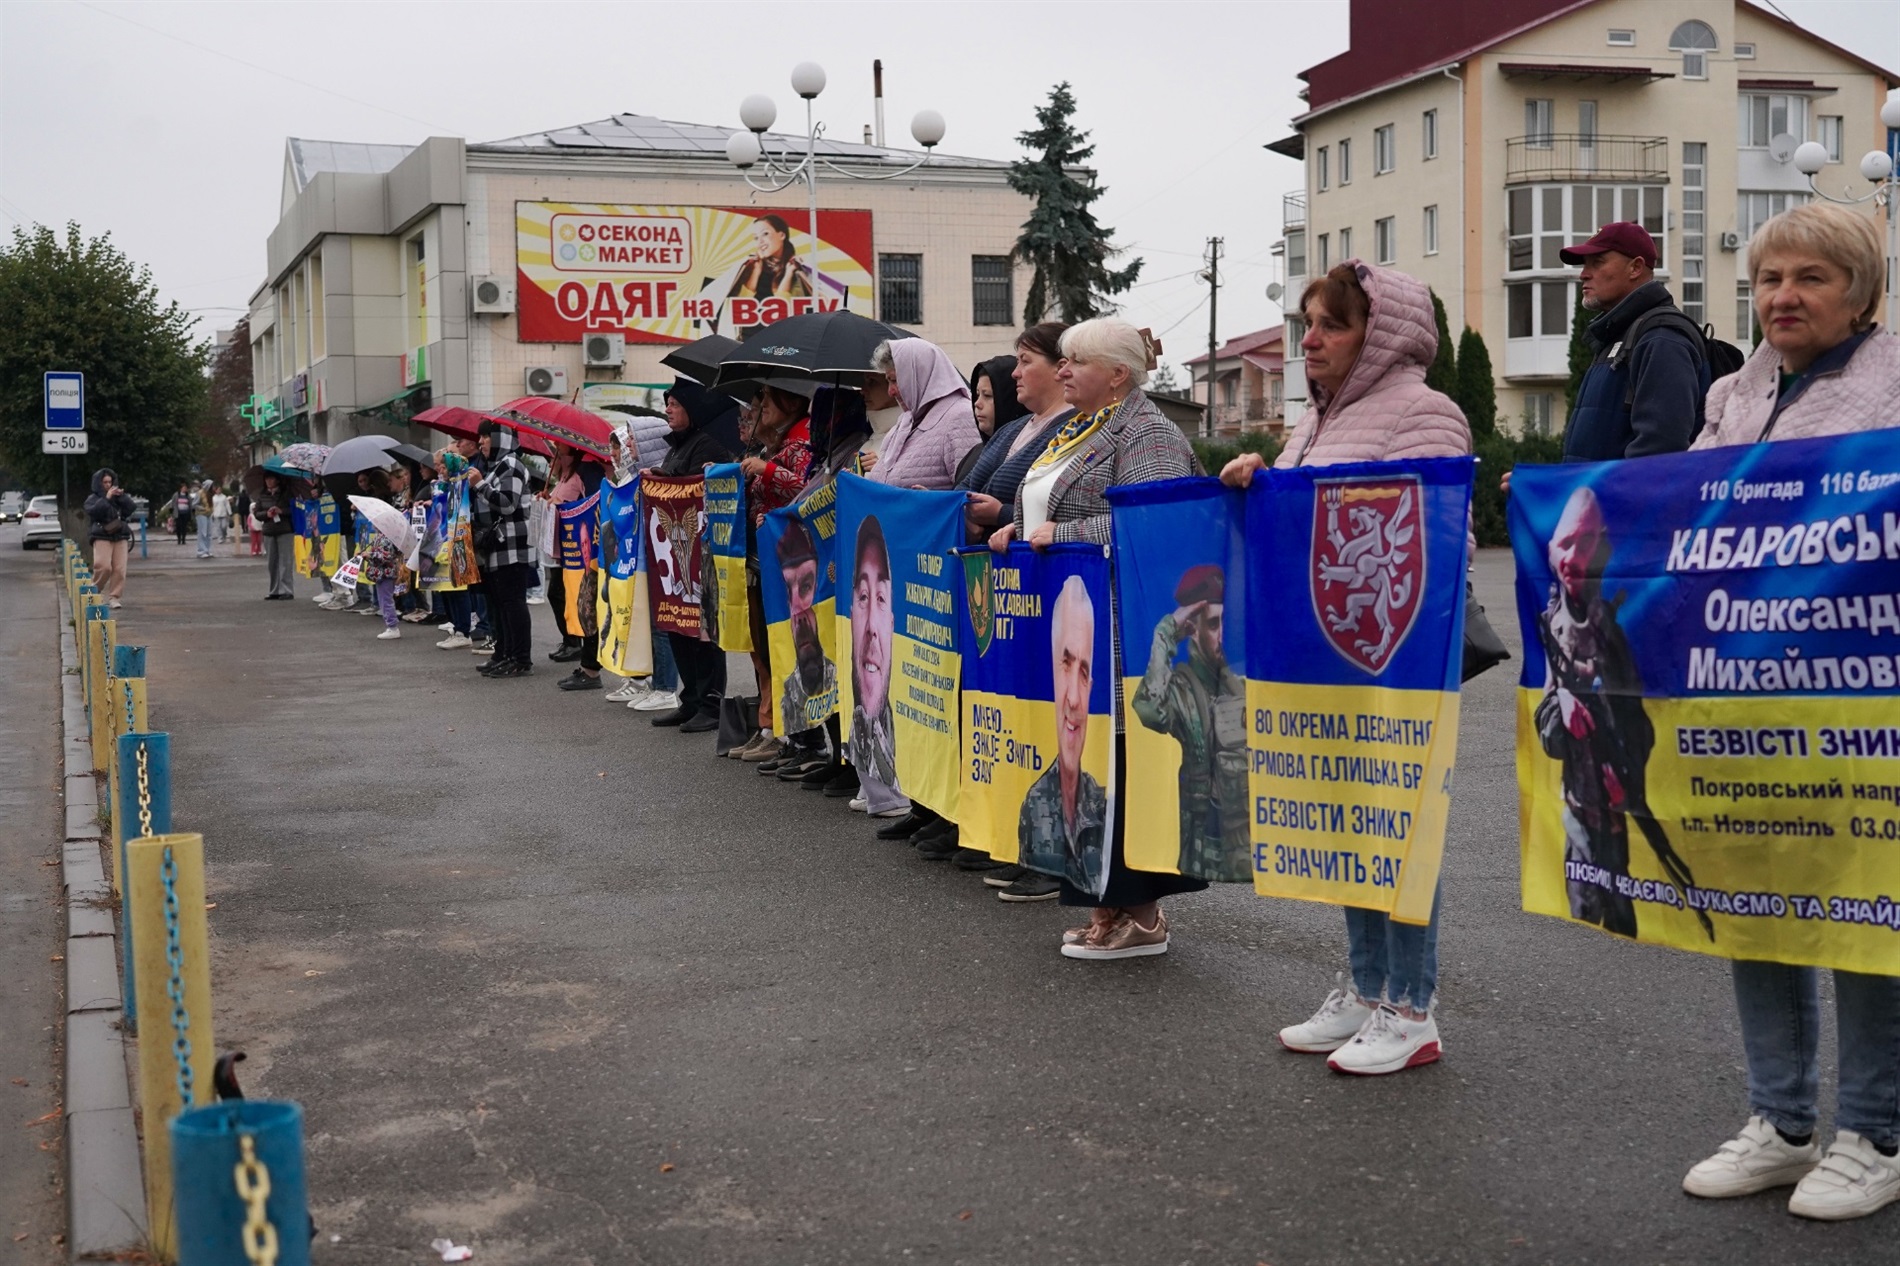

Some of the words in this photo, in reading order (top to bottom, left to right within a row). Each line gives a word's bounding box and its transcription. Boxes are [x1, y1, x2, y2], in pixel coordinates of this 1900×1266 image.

[598, 225, 682, 245] СЕКОНД
[598, 247, 683, 264] МАРКЕТ
[557, 281, 677, 325] ОДЯГ
[682, 299, 714, 318] на
[61, 436, 76, 449] 50
[1700, 480, 1729, 501] 110
[1733, 478, 1804, 504] бригада
[1820, 471, 1854, 495] 116
[1705, 589, 1900, 635] Олександ
[1687, 647, 1900, 691] Михайлов
[1255, 709, 1273, 735] 80
[1279, 711, 1349, 740] ОКРЕМА
[1676, 727, 1808, 757] БЕЗВІСТІ
[1310, 755, 1399, 787] ГАЛИЦЬКА
[1691, 776, 1843, 802] Покровський
[1256, 796, 1345, 833] БЕЗВІСТИ
[1351, 805, 1411, 840] ЗНИКЛ
[1850, 816, 1900, 840] 03.0
[1253, 843, 1268, 872] Е
[1275, 844, 1366, 884] ЗНАЧИТЬ
[1789, 897, 1825, 919] ТА
